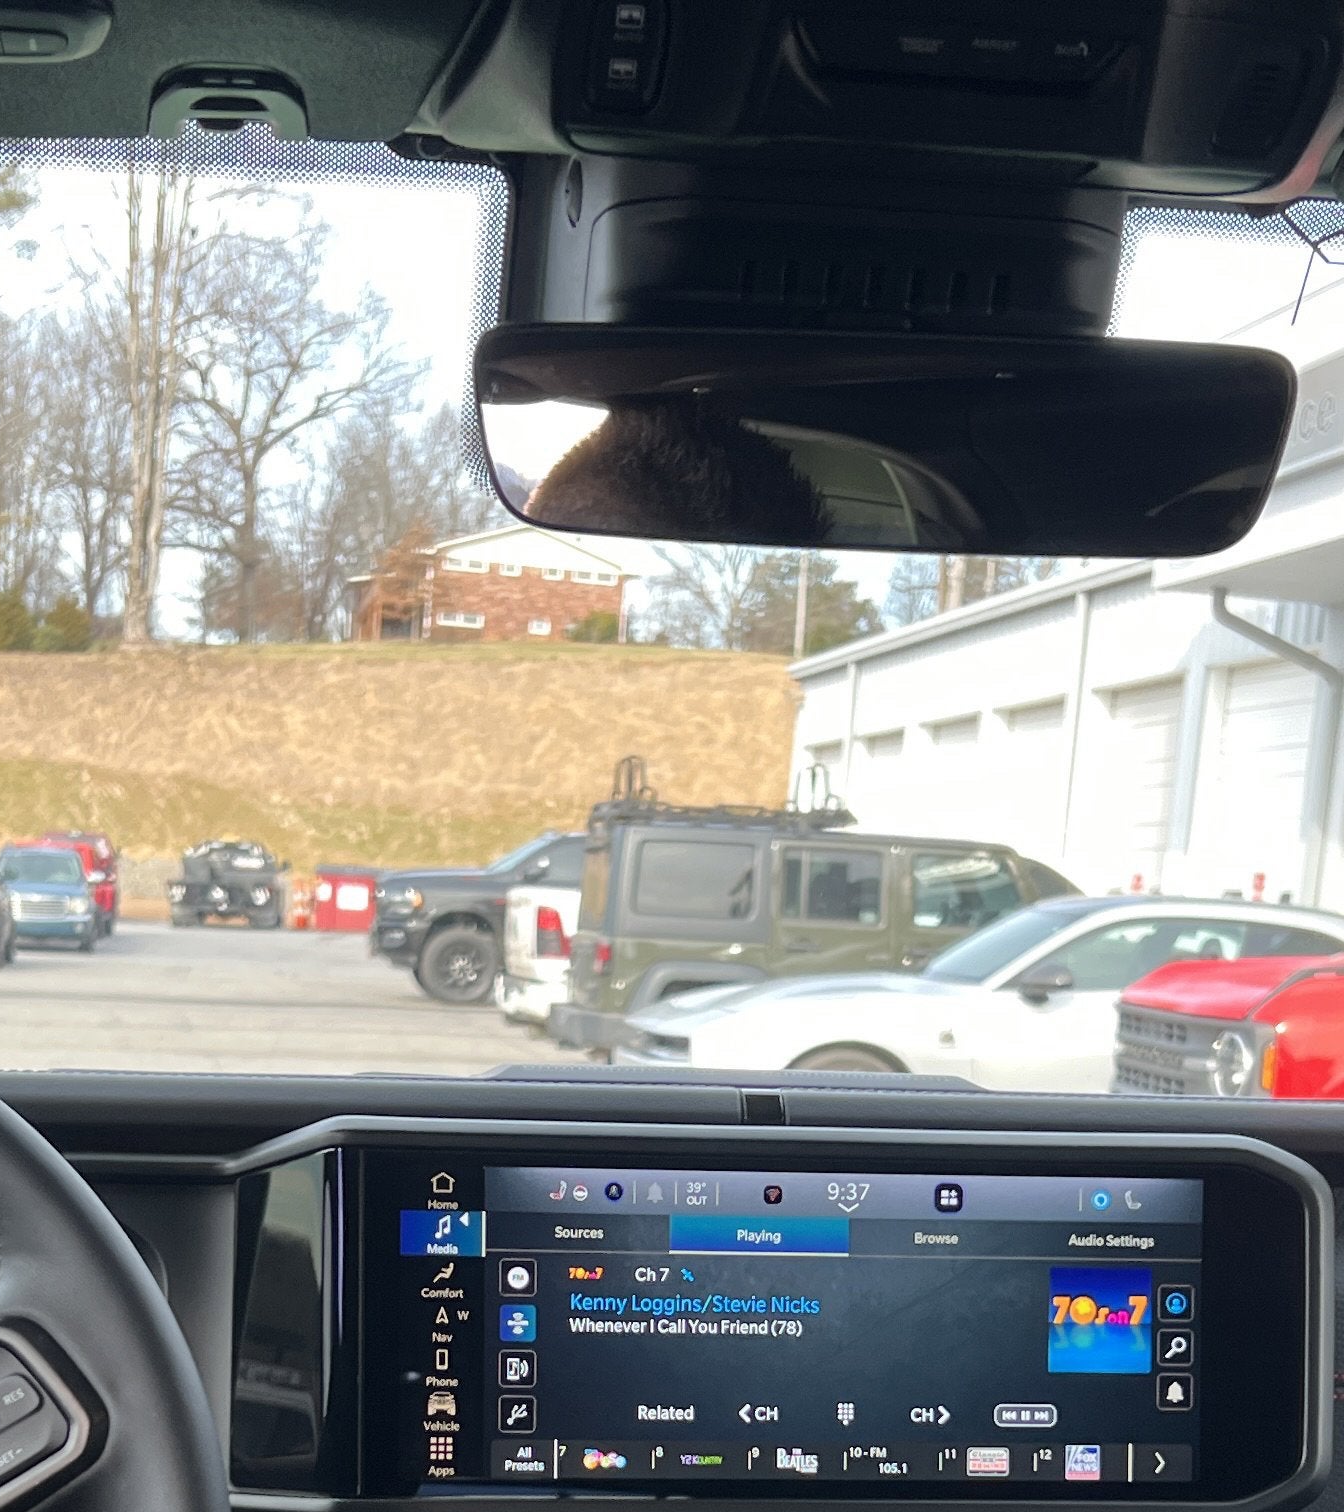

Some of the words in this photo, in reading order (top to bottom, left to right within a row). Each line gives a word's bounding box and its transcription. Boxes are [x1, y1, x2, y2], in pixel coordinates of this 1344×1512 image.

[827, 1183, 871, 1201] 9:37
[427, 1200, 459, 1211] Home
[686, 1196, 707, 1206] OUT
[554, 1226, 604, 1239] Sources
[736, 1229, 782, 1244] Playing
[913, 1232, 959, 1245] Browse
[426, 1243, 458, 1254] Media
[1068, 1234, 1104, 1248] Audio
[1106, 1235, 1155, 1250] Settings
[634, 1267, 655, 1282] Ch
[659, 1267, 670, 1282] 7
[421, 1287, 464, 1299] Comfort
[569, 1294, 628, 1315] Kenny
[631, 1294, 767, 1315] Loggins/Stevie
[771, 1294, 820, 1315] Nicks
[1129, 1296, 1148, 1325] 7
[457, 1309, 470, 1322] W
[568, 1318, 648, 1334] Whenever
[657, 1318, 686, 1334] Call
[688, 1319, 719, 1334] You
[721, 1319, 768, 1335] Friend
[771, 1319, 803, 1337] (78)
[432, 1332, 453, 1343] Nav
[425, 1376, 458, 1387] Phone
[2, 1387, 25, 1405] RES
[637, 1405, 694, 1421] Related
[755, 1407, 779, 1421] CH
[910, 1407, 935, 1422] CH
[423, 1420, 460, 1432] Vehicle
[518, 1447, 532, 1458] All
[559, 1445, 566, 1456] 7
[655, 1447, 663, 1458] 8
[752, 1447, 760, 1458] 9
[944, 1448, 956, 1459] 11
[1039, 1448, 1053, 1460] 12
[777, 1448, 819, 1468] BEATLES
[1079, 1453, 1097, 1462] FOX
[427, 1465, 455, 1478] Apps
[504, 1459, 545, 1473] Presets
[878, 1463, 908, 1474] 105.1
[1072, 1462, 1097, 1472] NEWS
